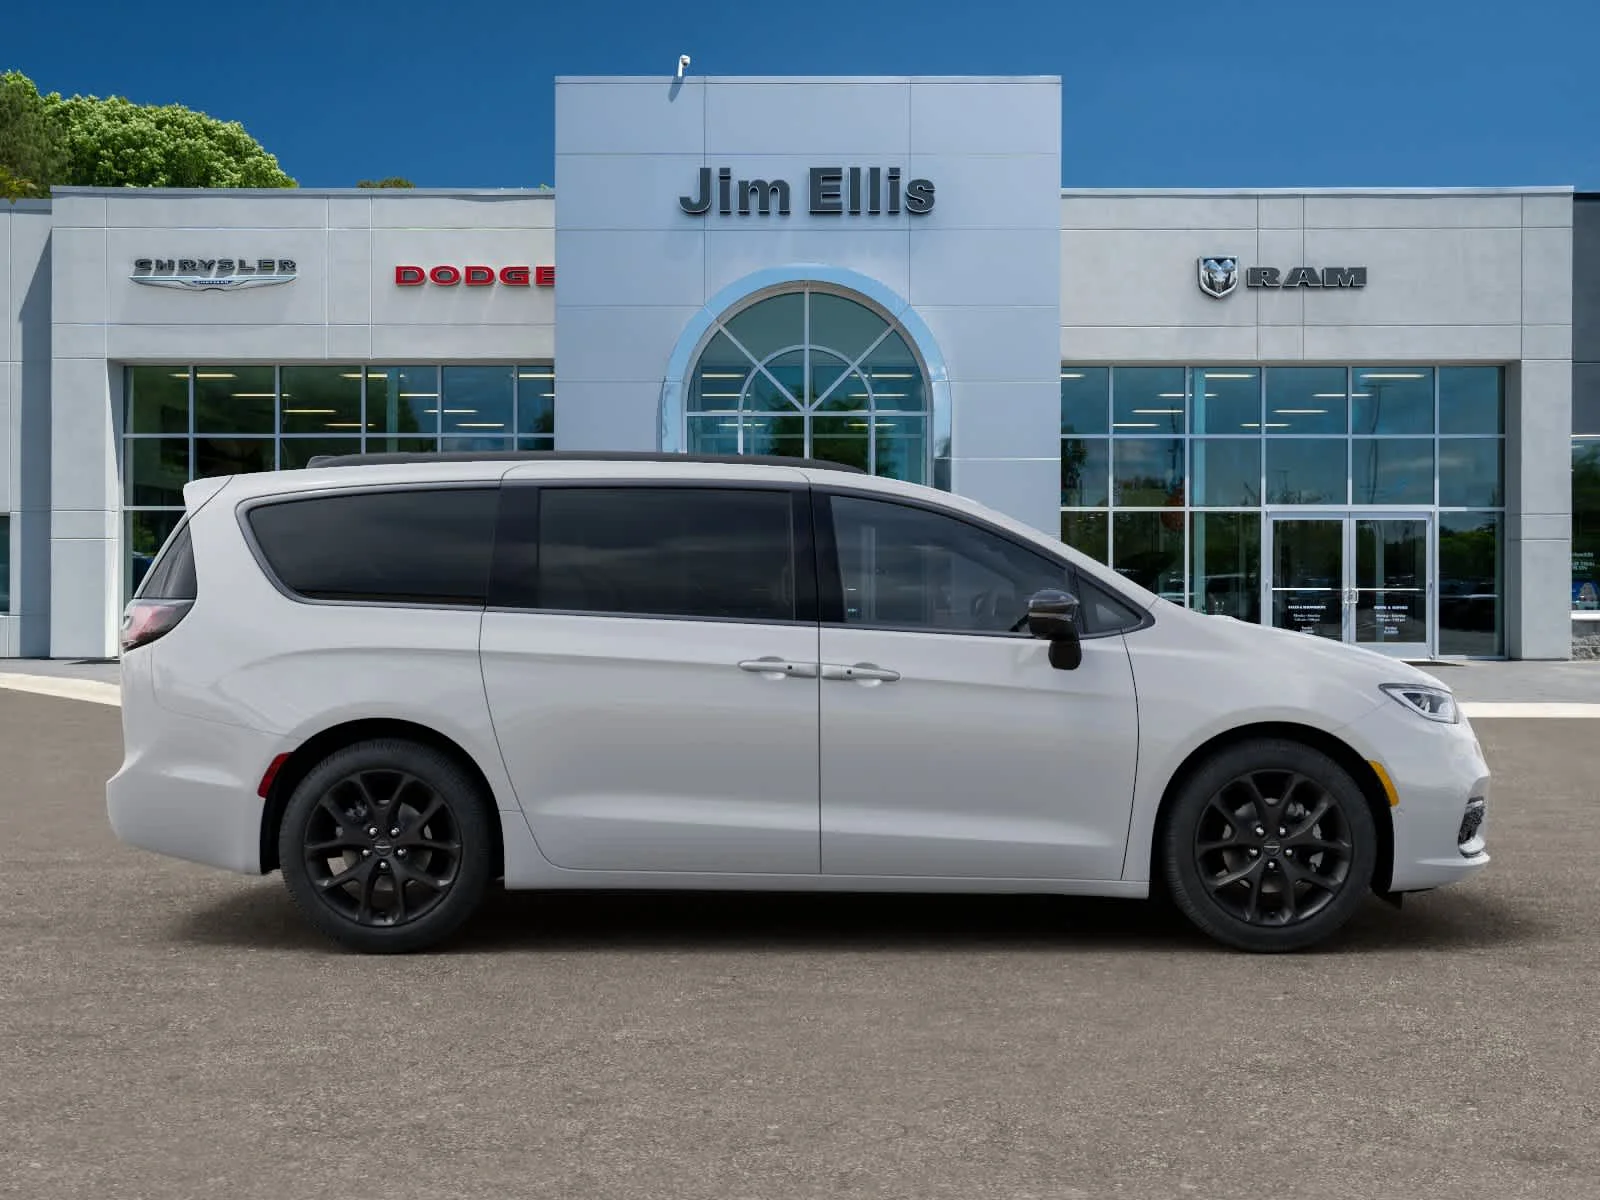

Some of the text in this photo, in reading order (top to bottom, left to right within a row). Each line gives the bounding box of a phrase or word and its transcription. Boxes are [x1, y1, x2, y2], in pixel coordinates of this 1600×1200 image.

[679, 167, 936, 215] Jim Ellis
[135, 258, 297, 272] CHRYSLER
[395, 266, 555, 286] DODGE
[1247, 267, 1367, 287] RAM
